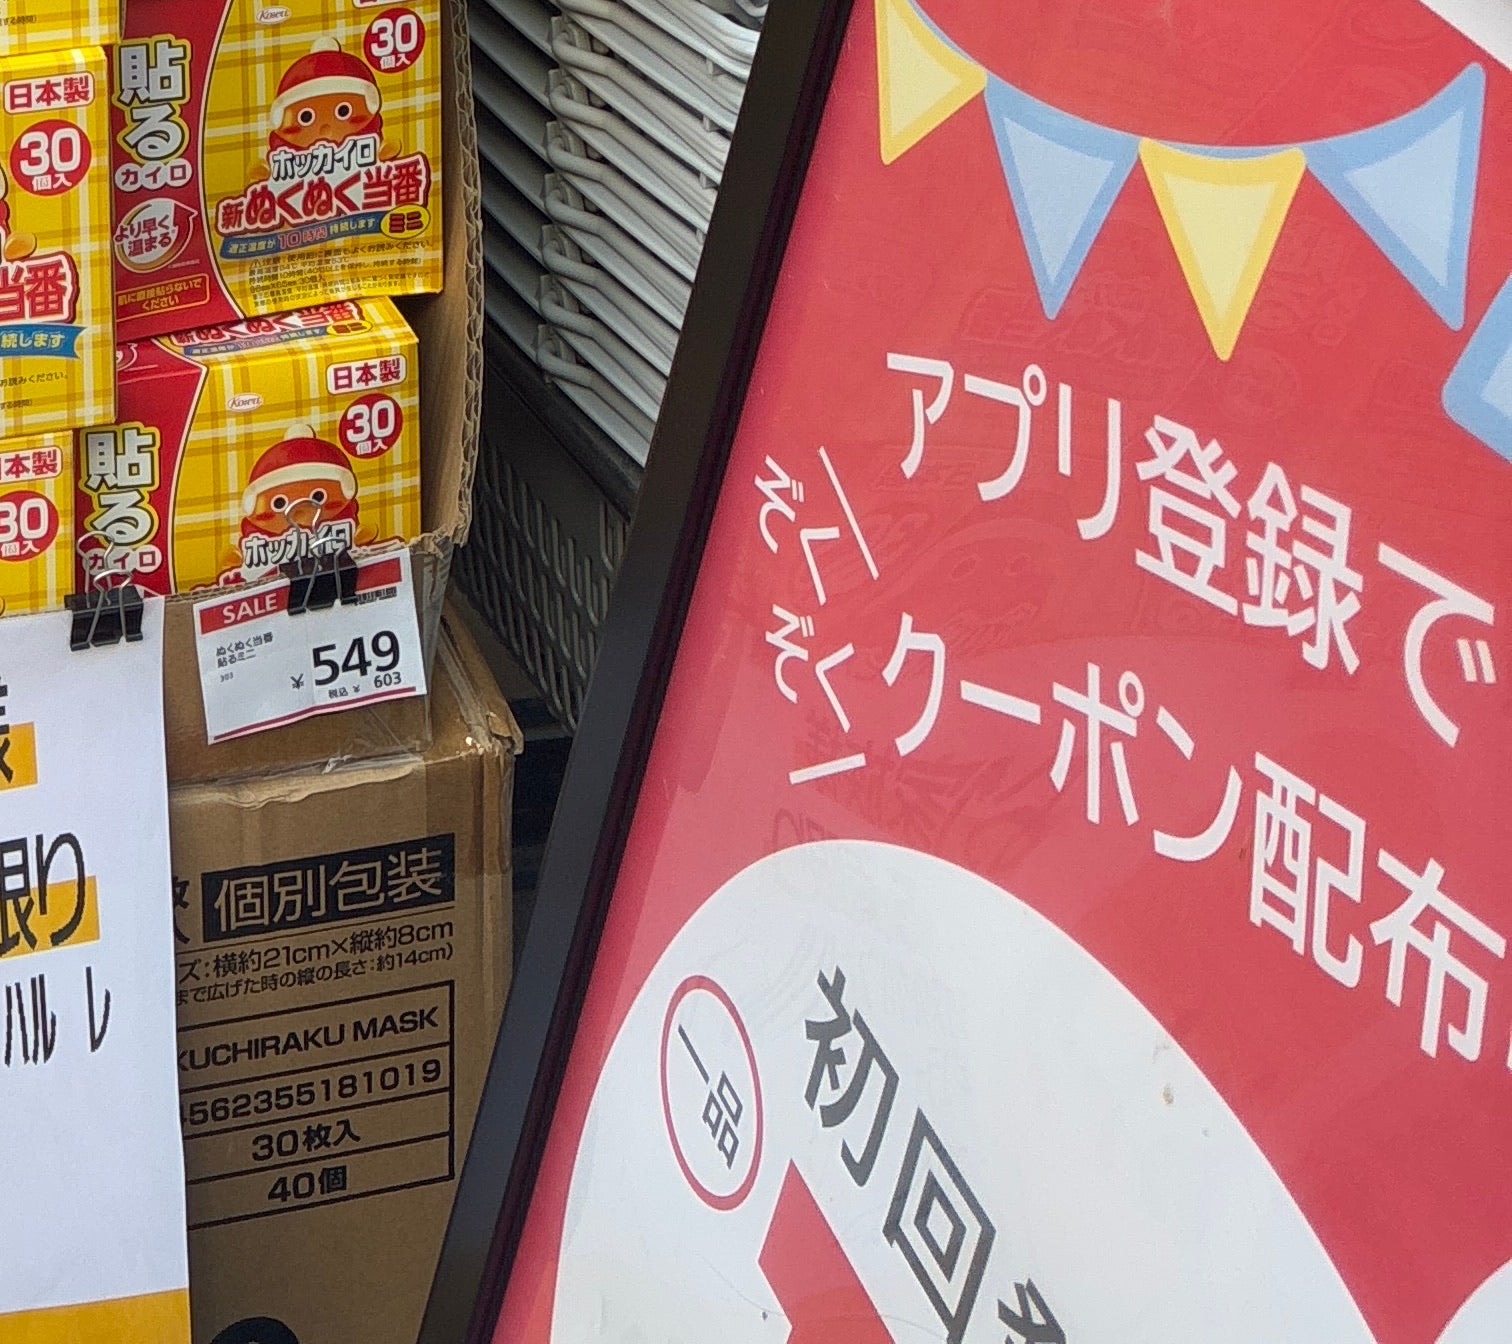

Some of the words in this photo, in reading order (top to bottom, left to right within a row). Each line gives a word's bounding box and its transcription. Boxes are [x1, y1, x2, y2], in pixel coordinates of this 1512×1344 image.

[886, 350, 1498, 748] アプリ登録で
[223, 593, 278, 624] SALE
[216, 631, 274, 657] ぬくぬく当番
[217, 648, 256, 669] 貼るミニ
[312, 630, 401, 687] 549
[374, 671, 402, 689] 603
[880, 611, 1512, 1070] クーポン配布
[213, 848, 443, 934] 個別包装
[353, 1005, 440, 1043] MASK
[251, 1118, 362, 1163] 30枚入
[267, 1164, 348, 1203] 40個
